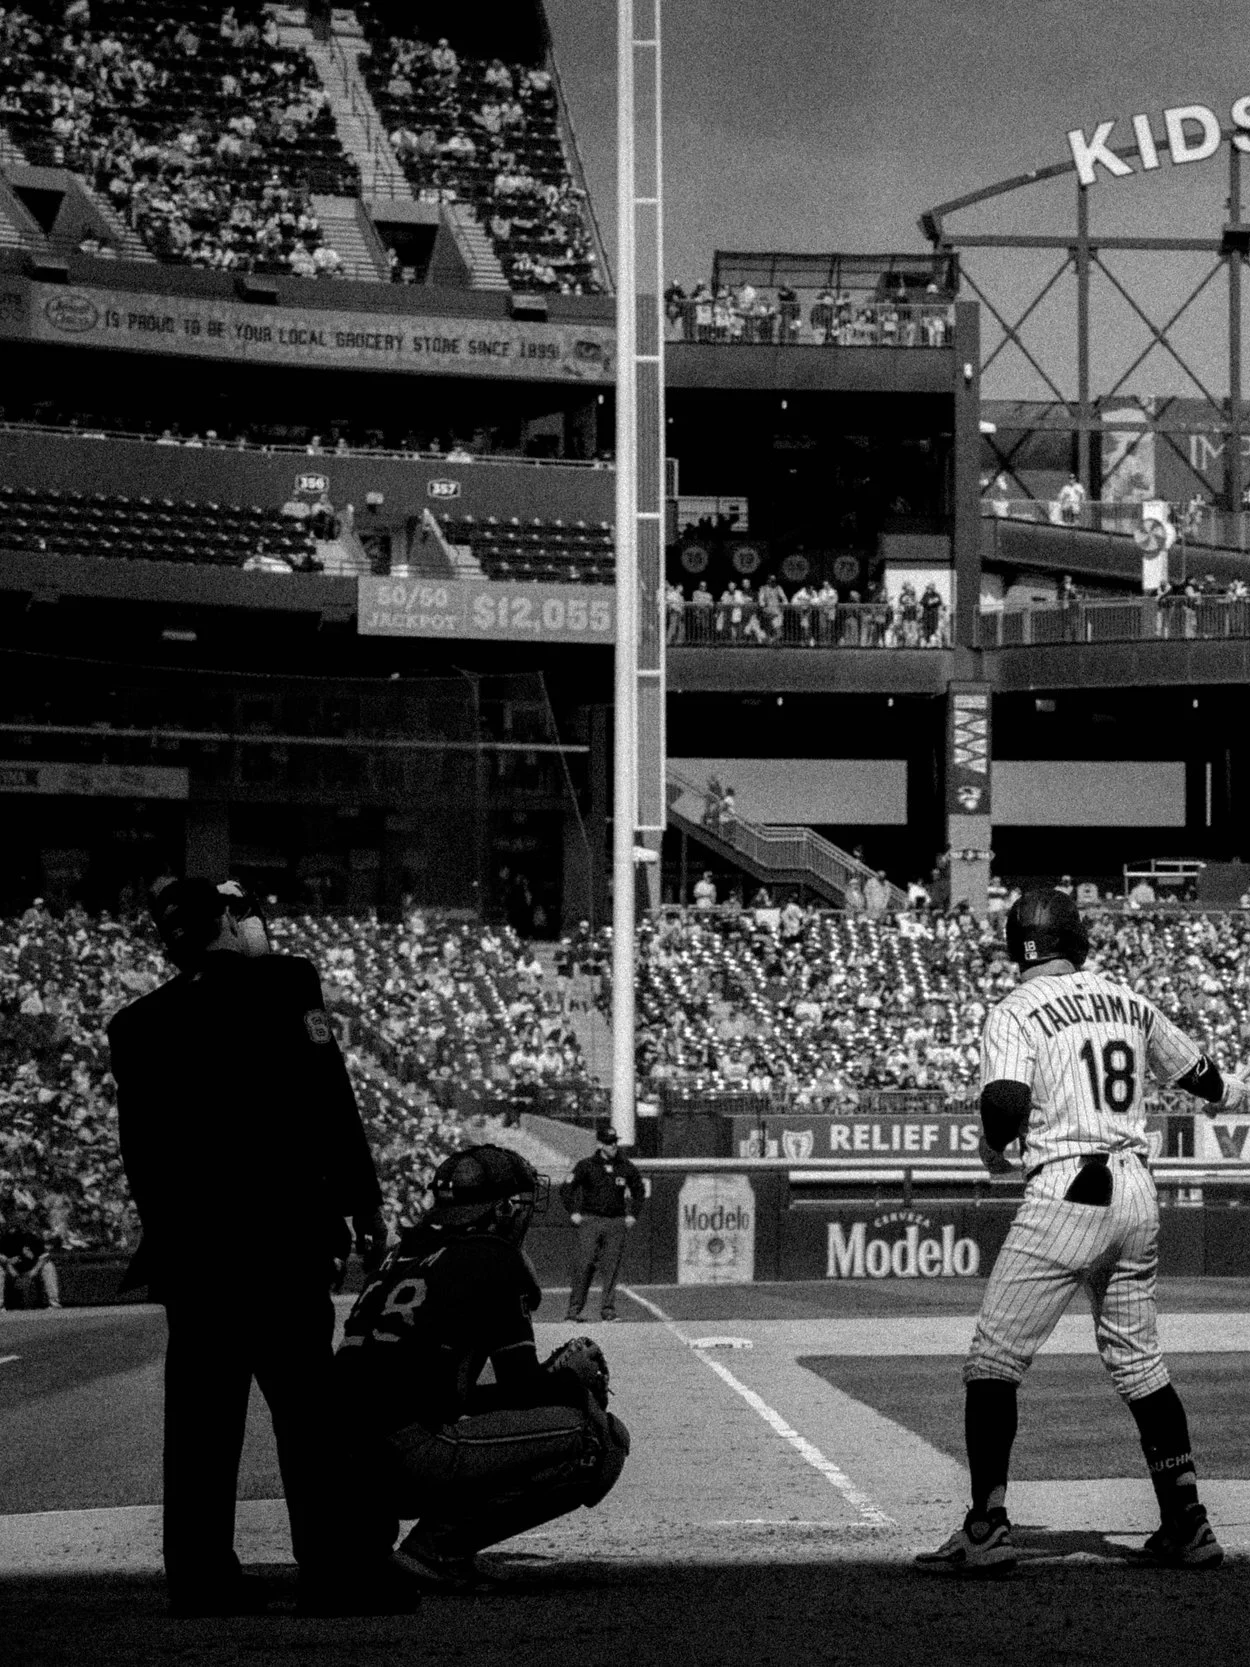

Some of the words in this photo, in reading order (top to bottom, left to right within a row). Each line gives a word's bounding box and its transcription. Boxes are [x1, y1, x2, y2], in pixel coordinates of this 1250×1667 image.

[105, 310, 119, 328] IS
[127, 313, 175, 333] PROUD
[184, 318, 200, 336] TO
[235, 323, 272, 342] YOUR
[278, 327, 327, 347] LOCAL
[335, 331, 404, 351] GROCERY
[412, 335, 460, 355] STORE
[467, 339, 510, 358] SINCE
[432, 482, 457, 495] 357
[367, 611, 457, 631] JACKPOT
[472, 593, 612, 633] $12,055
[1029, 993, 1155, 1040] TAUCHMAN
[1080, 1038, 1135, 1113] 18
[830, 1124, 940, 1151] RELIEF
[949, 1124, 980, 1150] IS
[683, 1204, 751, 1232] Modelo
[873, 1211, 931, 1229] CERVEZA
[826, 1222, 980, 1278] Modelo
